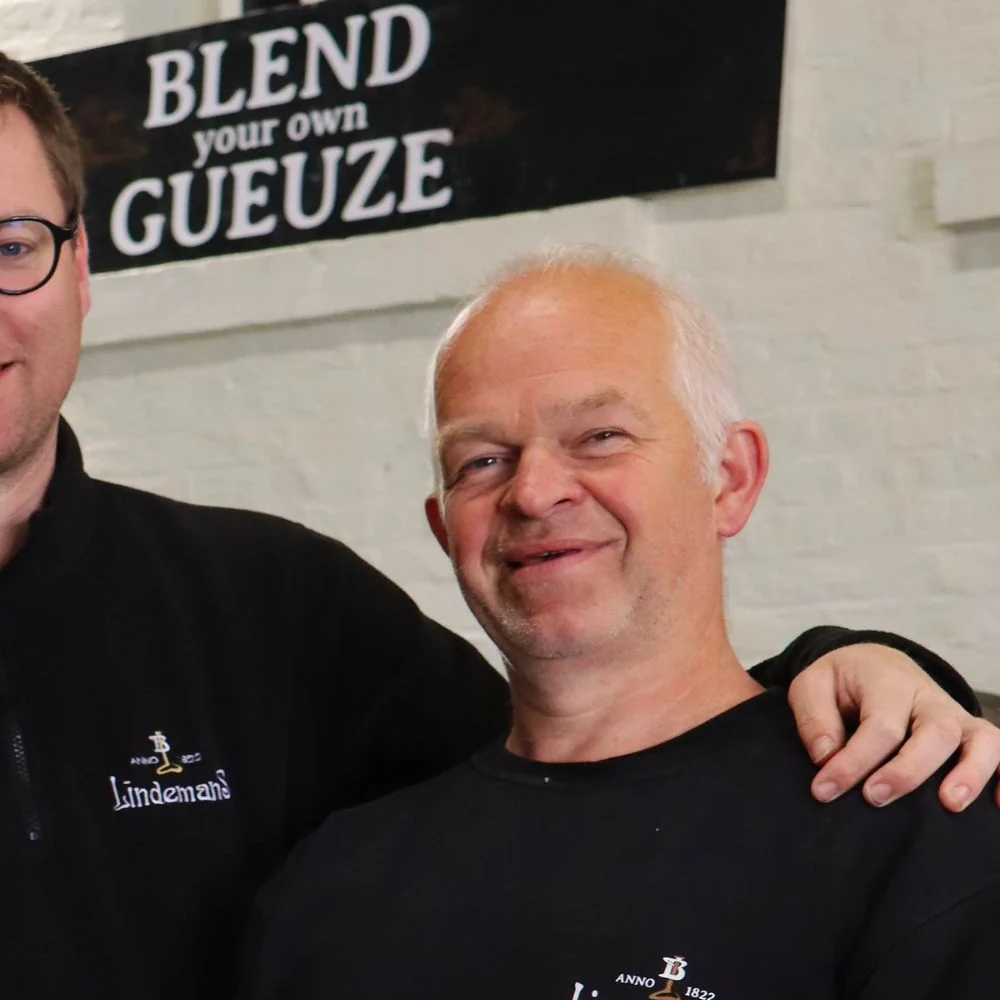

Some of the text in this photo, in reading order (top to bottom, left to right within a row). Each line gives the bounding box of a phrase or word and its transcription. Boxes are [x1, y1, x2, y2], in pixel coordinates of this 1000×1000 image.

[145, 5, 432, 129] BLEND
[192, 102, 369, 168] your own
[110, 129, 454, 257] GUEUZE
[615, 973, 656, 988] ANNO
